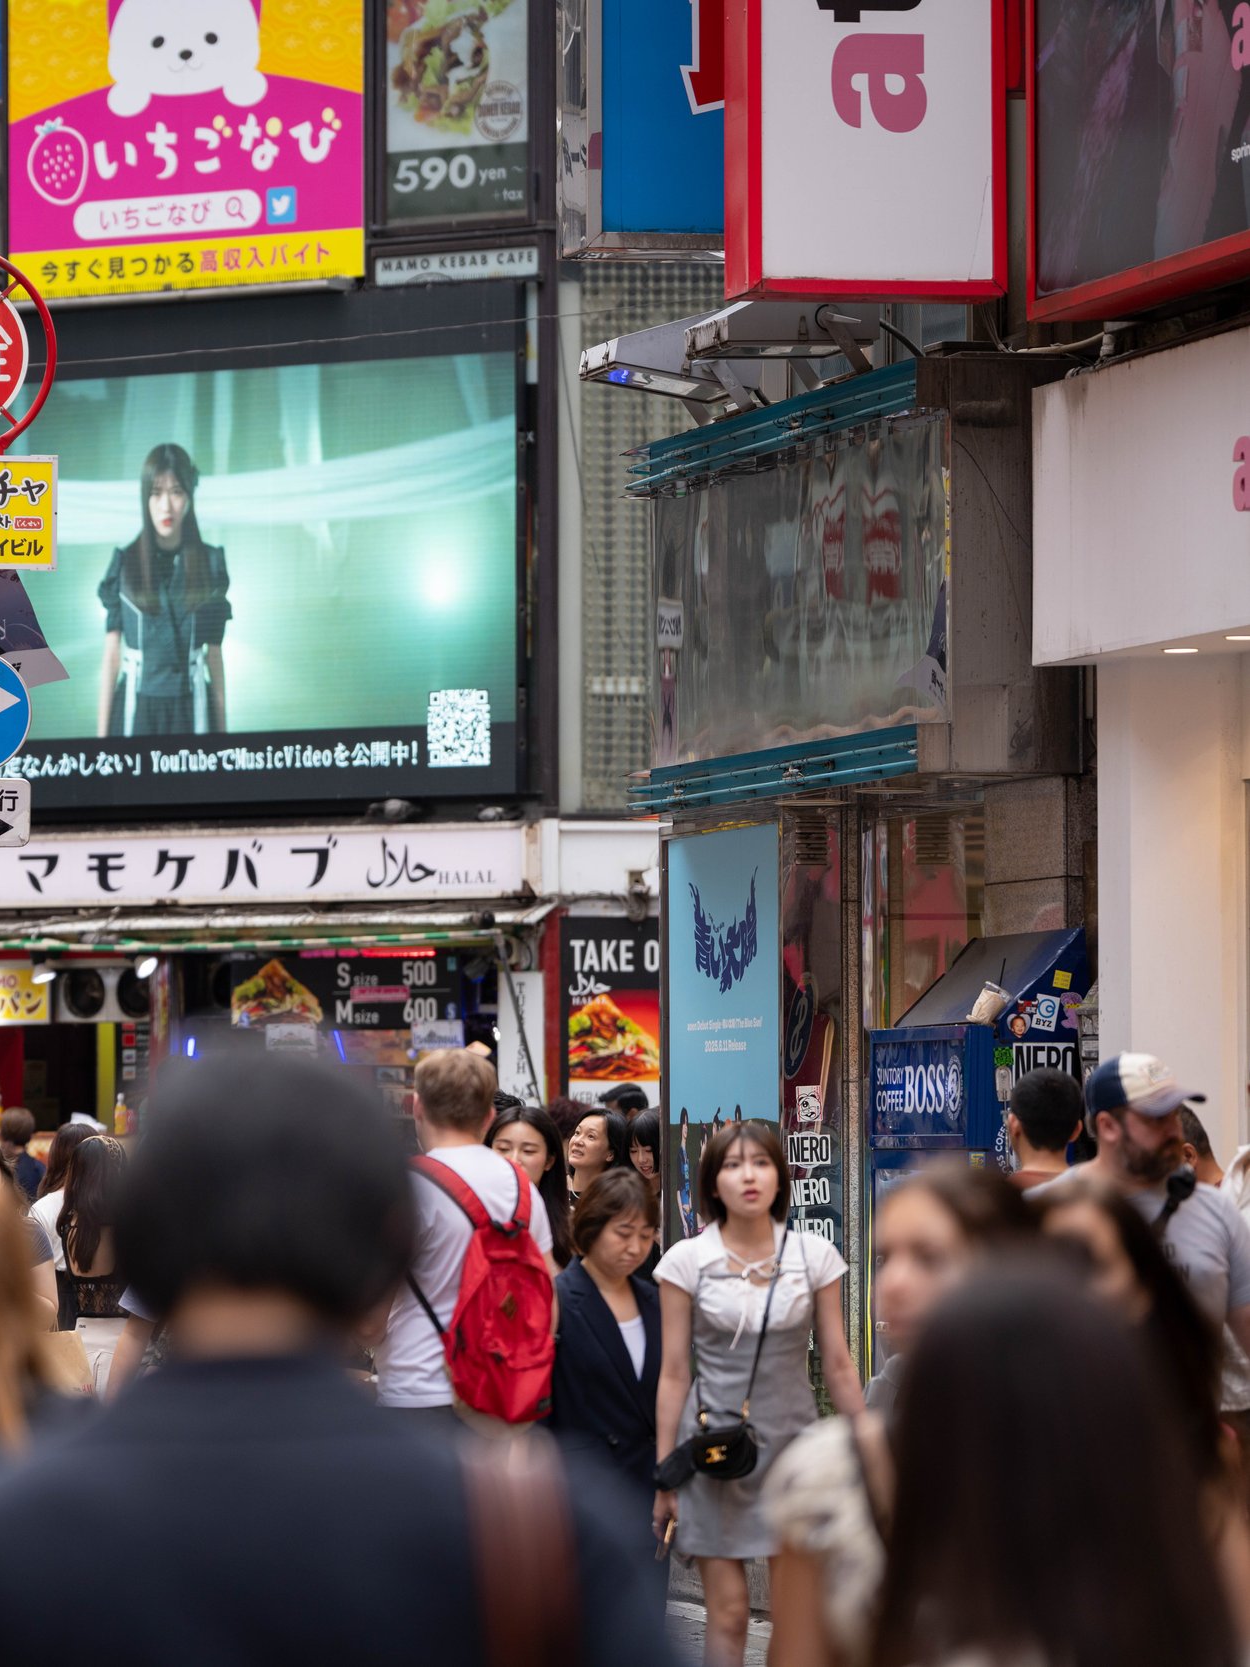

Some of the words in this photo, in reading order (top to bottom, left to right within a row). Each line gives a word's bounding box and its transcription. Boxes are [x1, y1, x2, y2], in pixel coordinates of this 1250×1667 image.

[93, 108, 342, 180] いちごなび
[393, 154, 476, 193] 590
[479, 167, 507, 186] yen
[99, 201, 211, 231] いちごなび
[40, 243, 330, 284] 今すぐ見つかる高収入バイト
[381, 258, 431, 272] MAMO
[439, 254, 488, 269] KEBAB
[497, 250, 533, 265] CAFE
[17, 833, 339, 894] マモケバブ
[366, 836, 437, 888] حلال
[439, 869, 497, 885] HALAL
[569, 939, 635, 972] TAKE
[337, 962, 351, 987] S
[353, 972, 379, 987] size
[402, 960, 438, 986] 500
[335, 999, 353, 1024] M
[354, 1009, 380, 1024] size
[402, 997, 438, 1023] 600
[1035, 1018, 1053, 1028] BYZ
[876, 1067, 904, 1085] SUNTORY
[904, 1063, 945, 1113] BOSS
[876, 1090, 904, 1112] COFFEE
[789, 1135, 830, 1163] NERO
[790, 1177, 831, 1207] NERO
